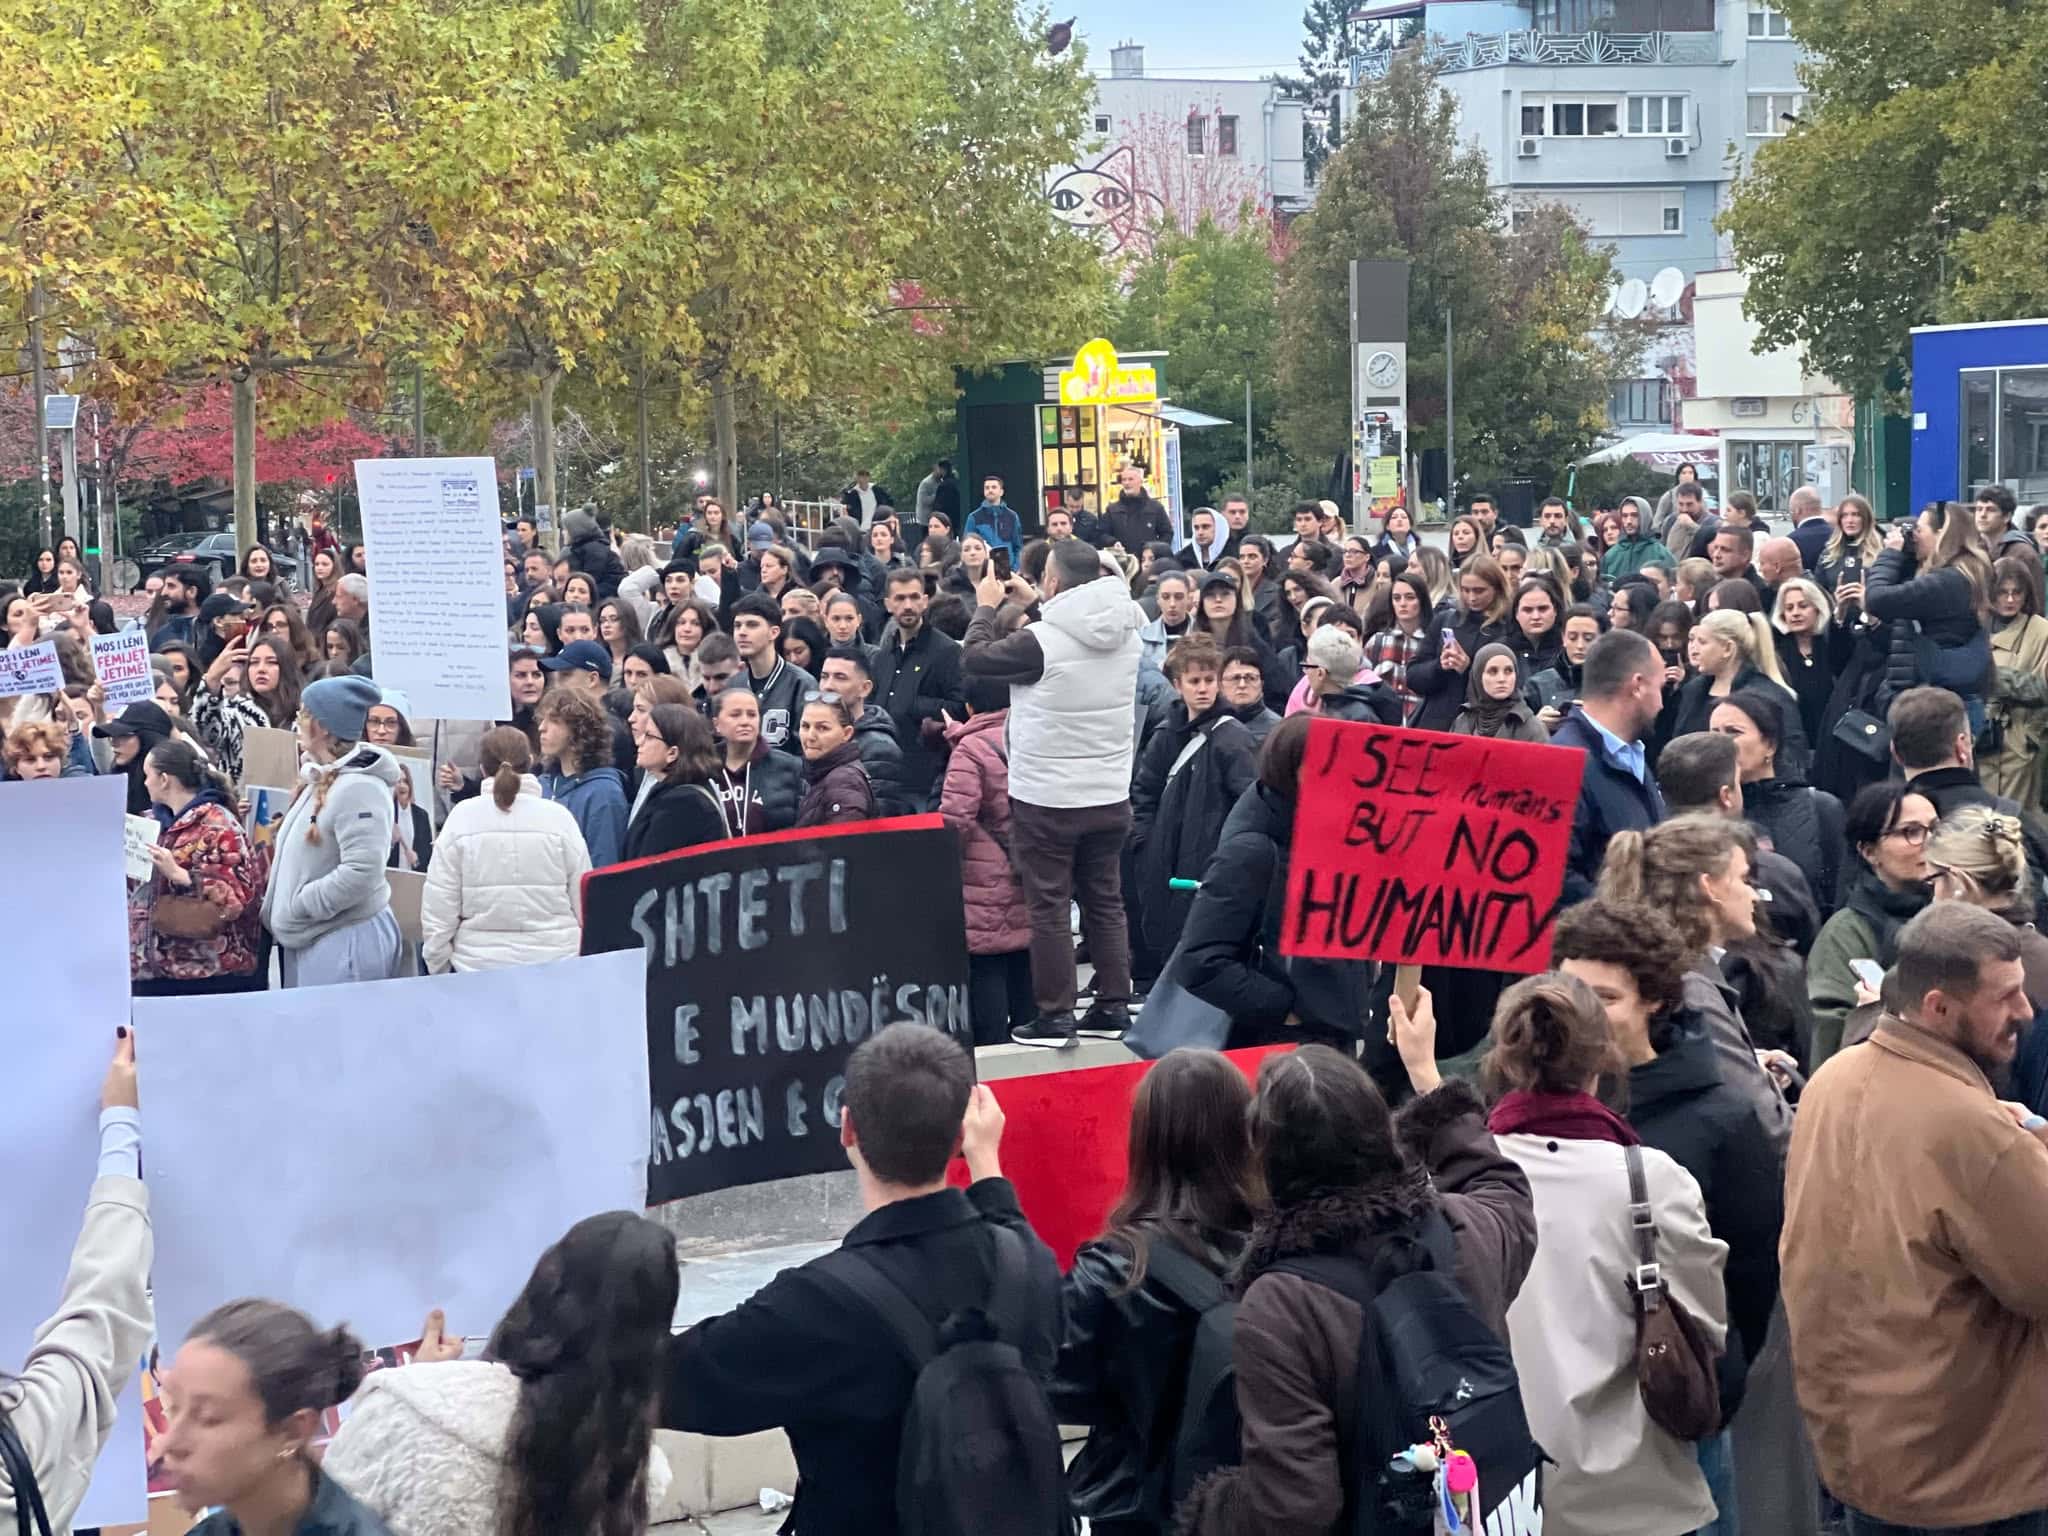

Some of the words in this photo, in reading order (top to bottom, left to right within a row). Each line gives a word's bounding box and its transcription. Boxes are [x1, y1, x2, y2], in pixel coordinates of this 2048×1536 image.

[95, 641, 115, 654] MOS
[1320, 729, 1341, 777] I
[1353, 734, 1462, 797] SEE
[1344, 801, 1438, 854] BUT
[1444, 813, 1539, 882] NO
[630, 858, 848, 968] SHTETI
[1296, 868, 1560, 961] HUMANITY
[674, 1003, 701, 1064] E
[730, 973, 969, 1056] MUNDËSON
[652, 1083, 764, 1166] ASJEN
[786, 1077, 809, 1137] E
